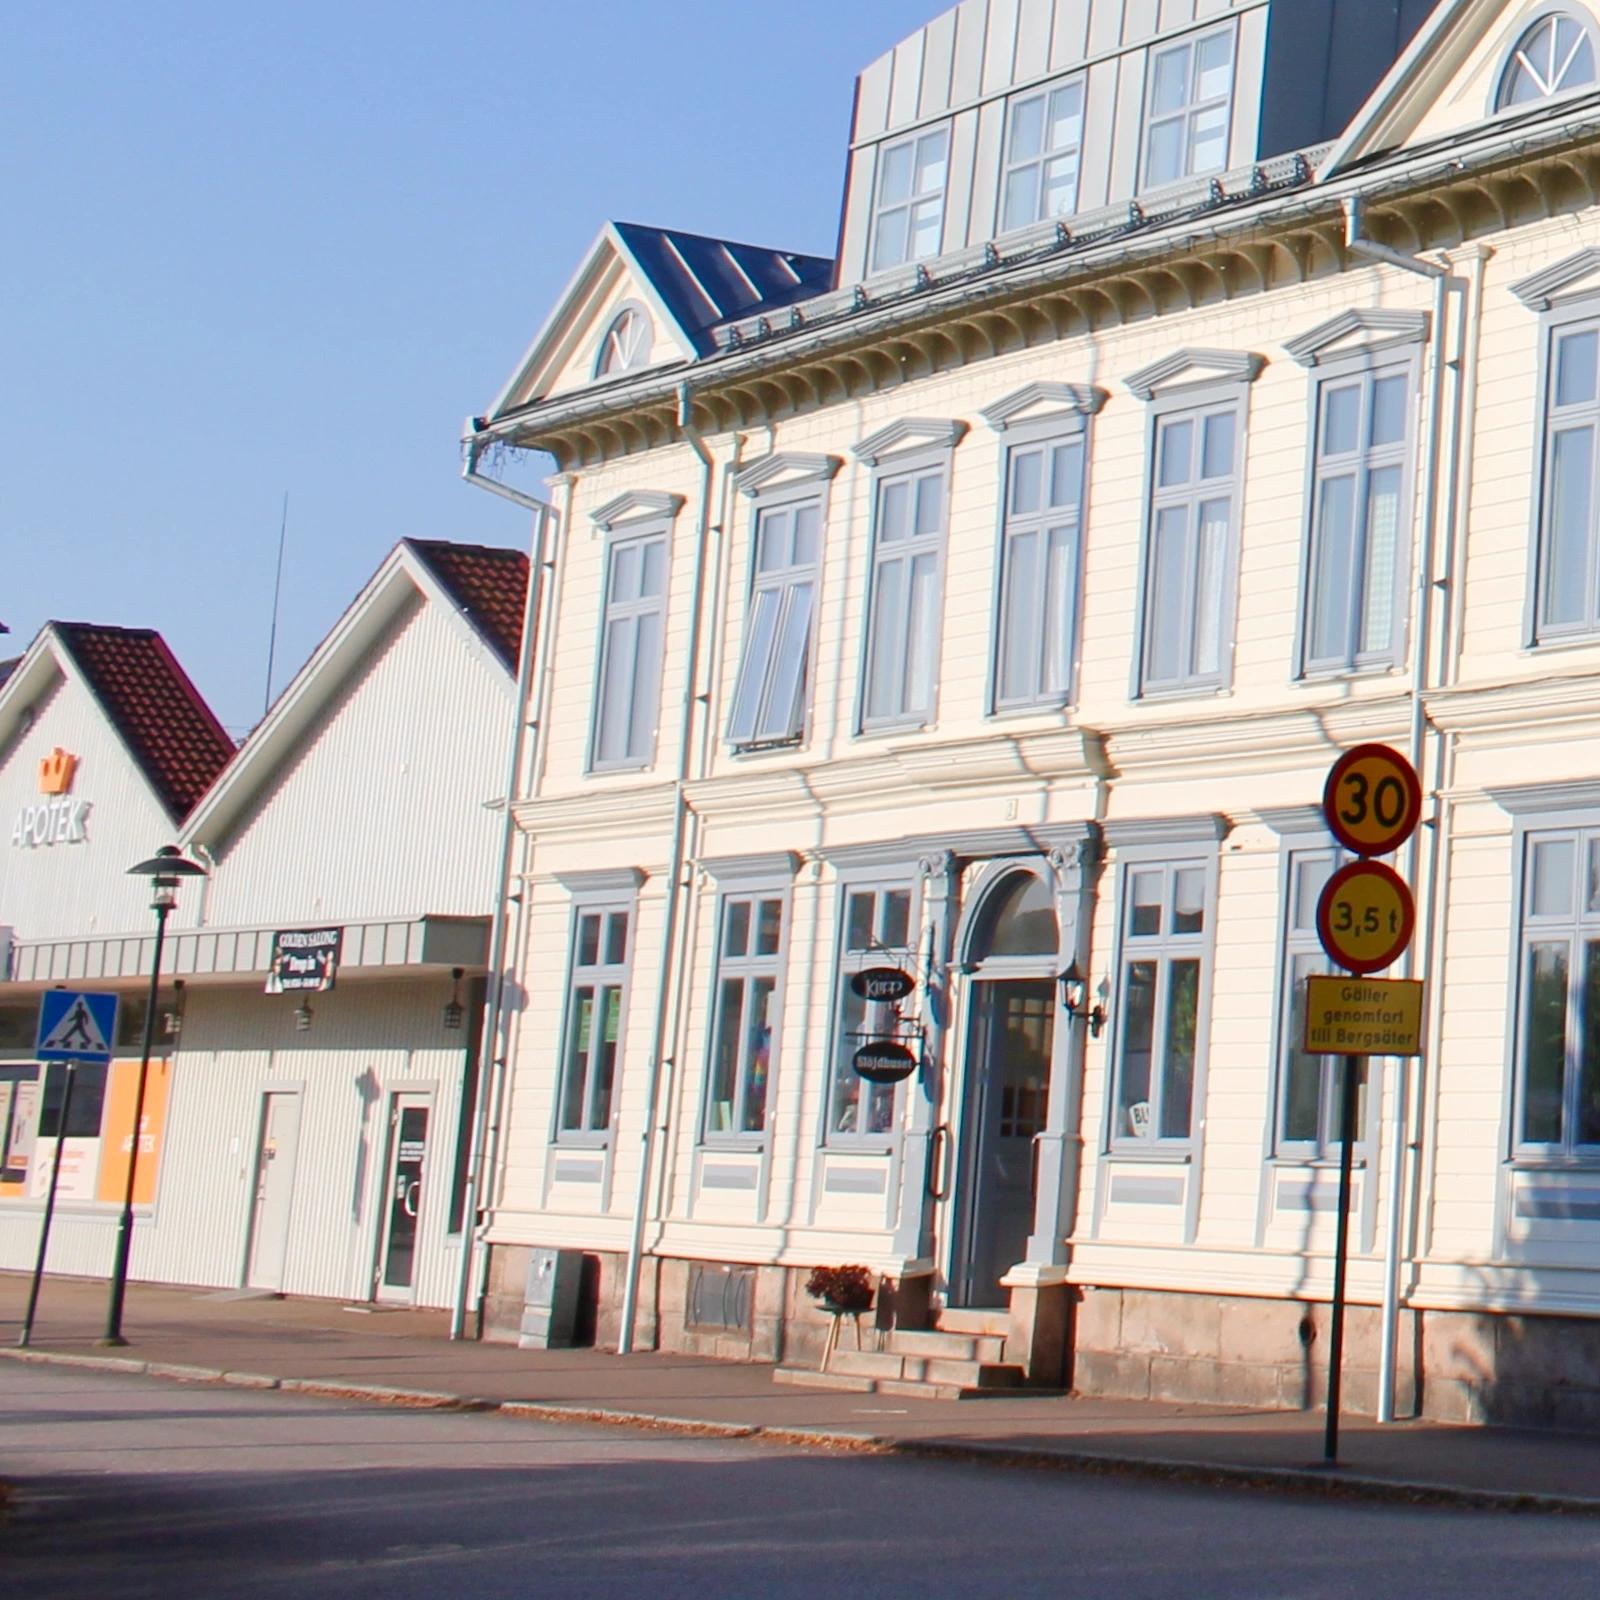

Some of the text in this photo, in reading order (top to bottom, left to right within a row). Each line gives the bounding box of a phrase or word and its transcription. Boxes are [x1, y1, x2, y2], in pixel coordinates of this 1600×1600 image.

[1341, 772, 1406, 828] 30
[12, 800, 88, 846] APOTEK
[1334, 902, 1397, 937] 3,5 t
[1341, 985, 1388, 1002] Gäller
[1323, 1009, 1404, 1025] genomfart
[1311, 1028, 1413, 1048] till Bergsäter
[856, 1055, 913, 1071] Slöjdhuset
